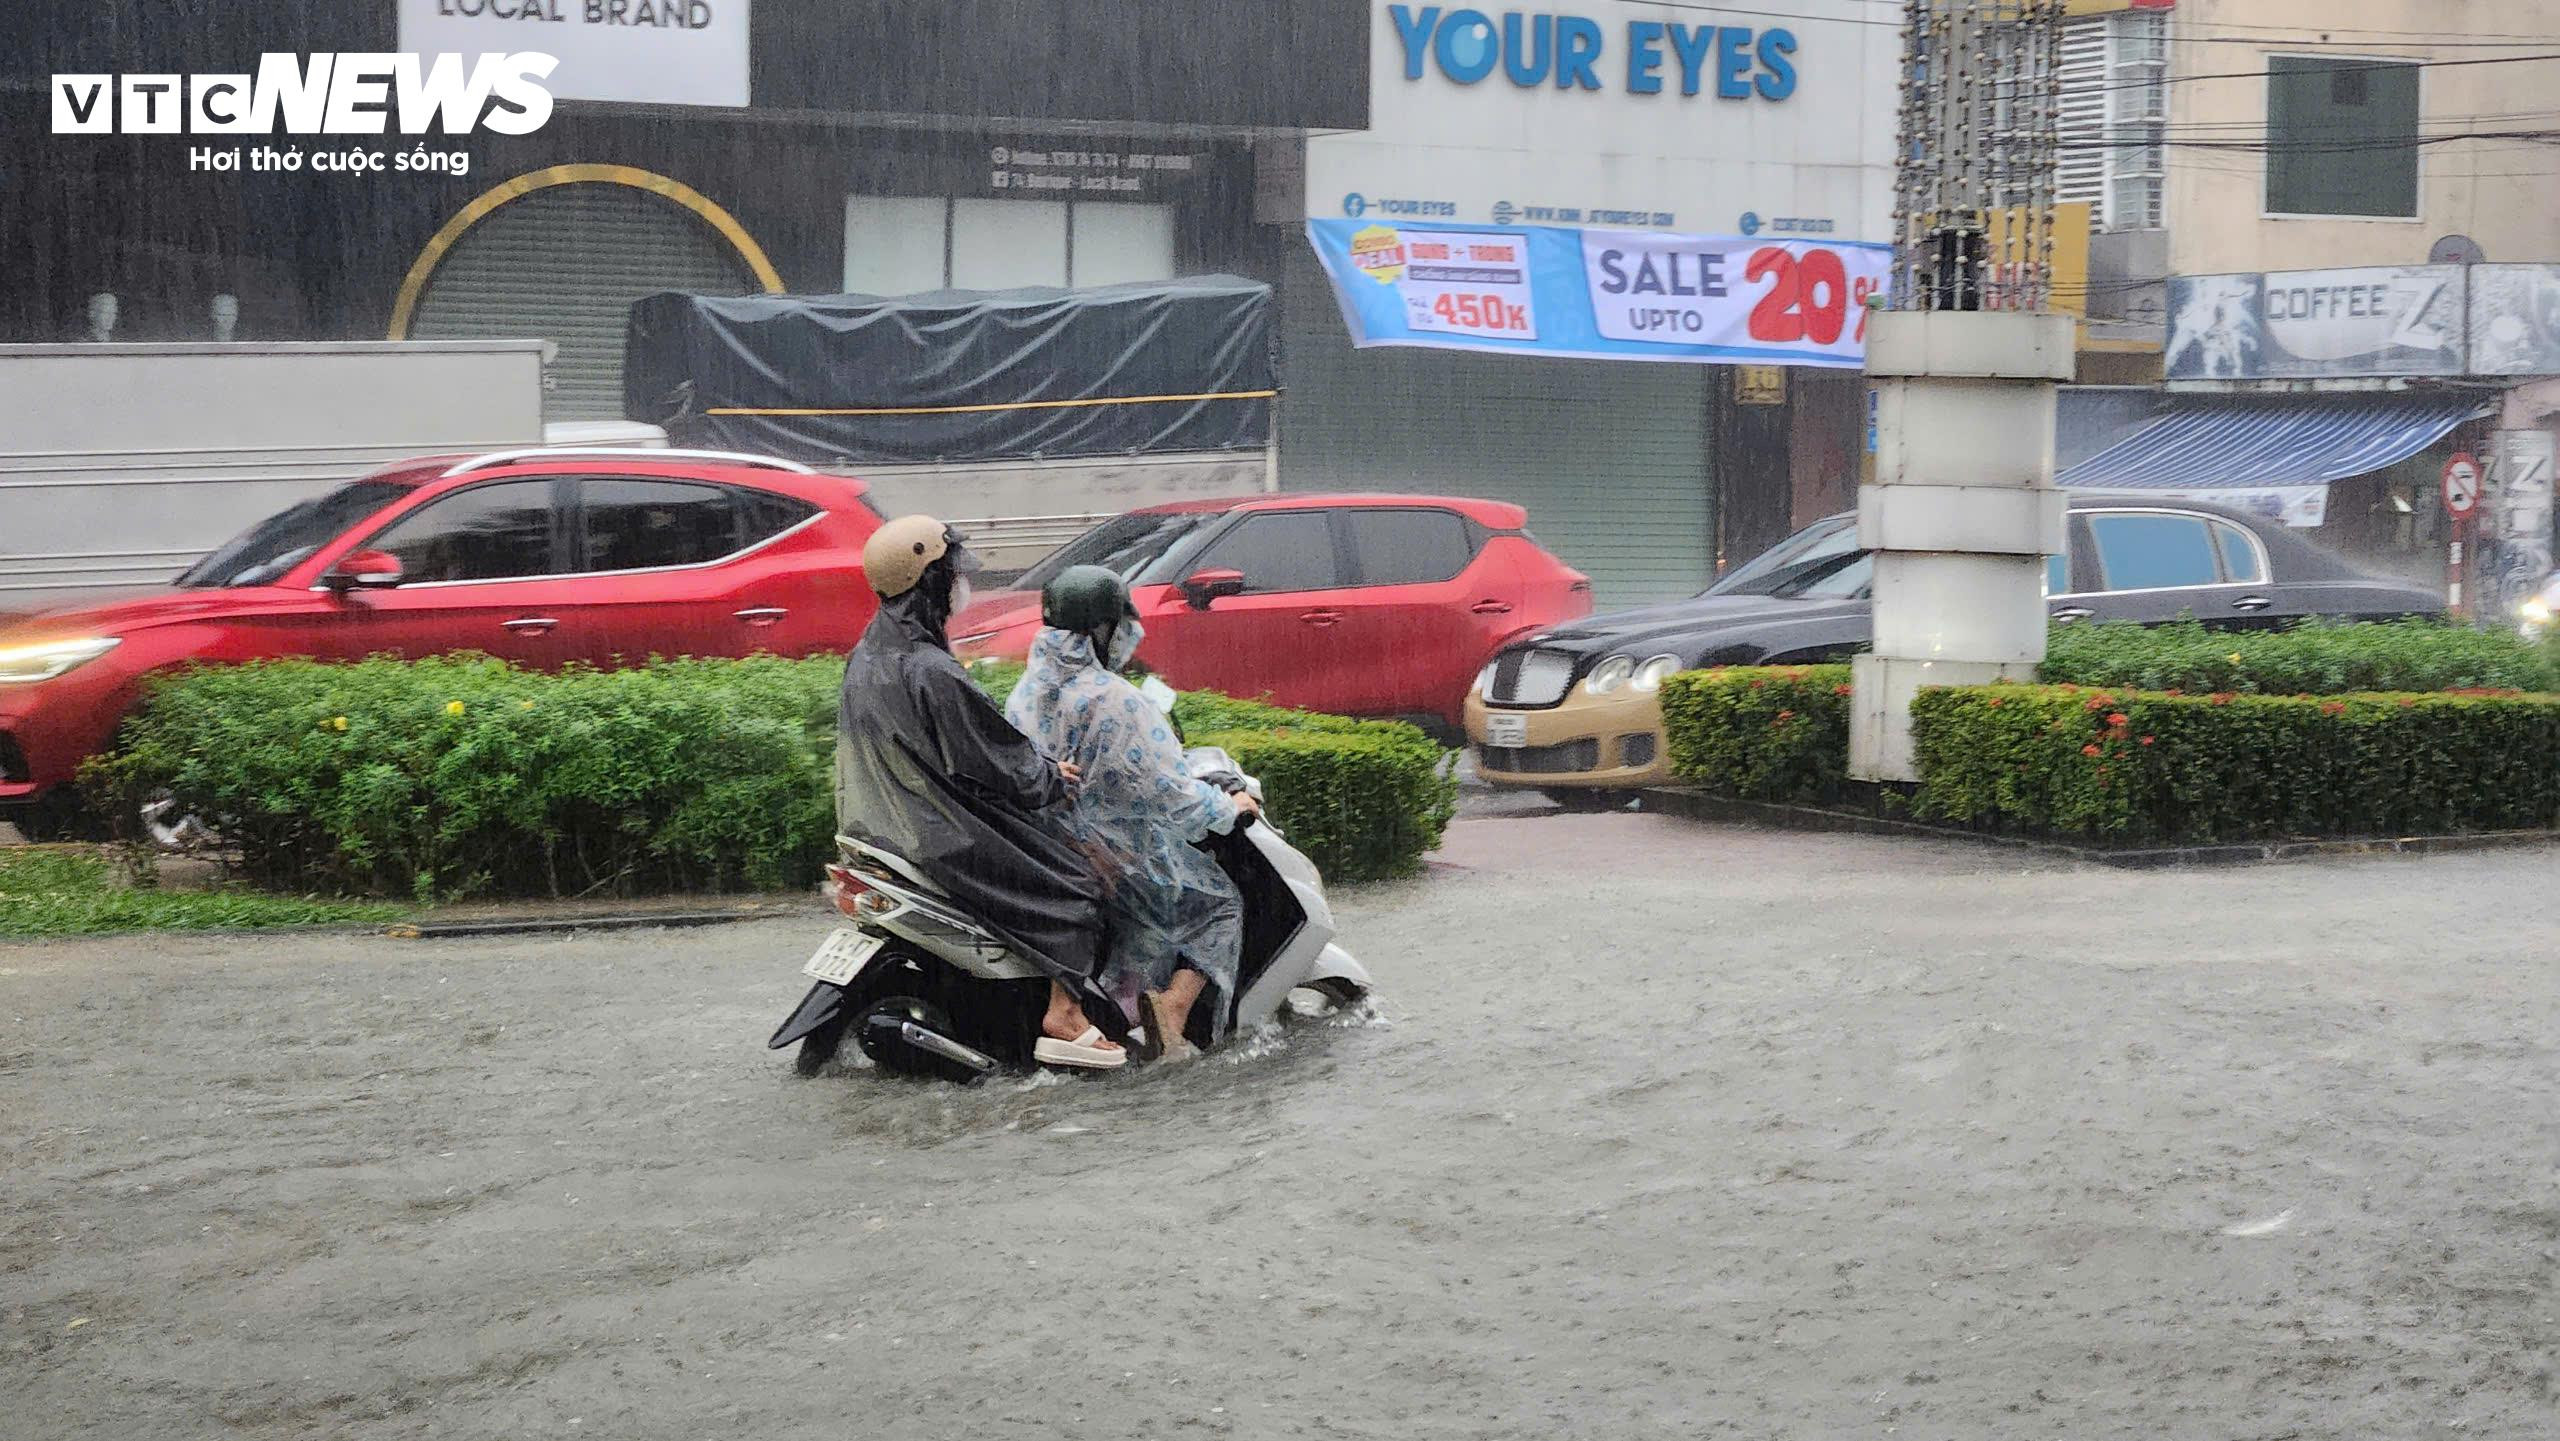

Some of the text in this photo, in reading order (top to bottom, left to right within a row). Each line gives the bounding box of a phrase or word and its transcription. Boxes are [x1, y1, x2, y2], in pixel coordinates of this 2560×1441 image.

[438, 0, 712, 28] LOCAL BRAND
[1387, 4, 1798, 102] YOUR EYES
[1378, 199, 1456, 216] YOUR EYES
[1600, 249, 1728, 298] SALE
[2266, 284, 2389, 320] COFFEE
[1629, 308, 1704, 332] UPTO
